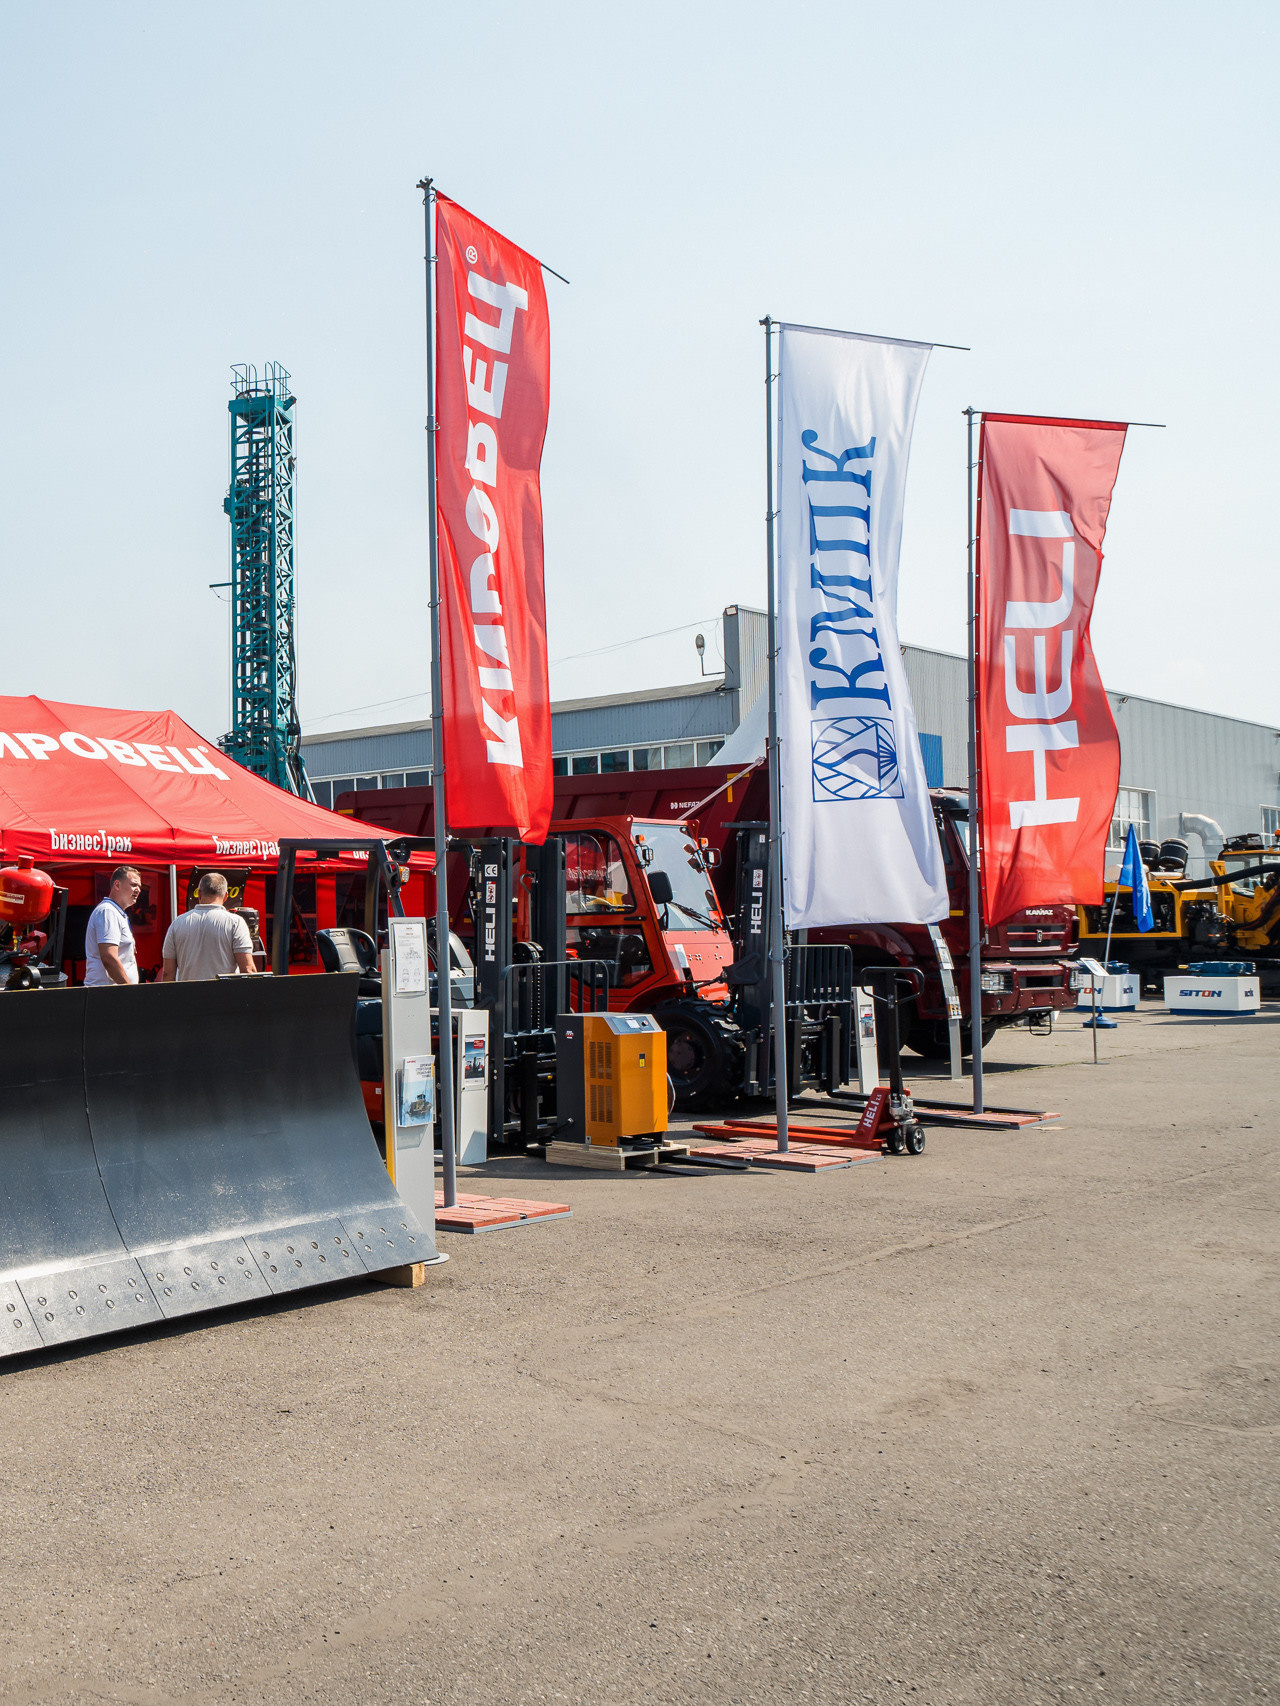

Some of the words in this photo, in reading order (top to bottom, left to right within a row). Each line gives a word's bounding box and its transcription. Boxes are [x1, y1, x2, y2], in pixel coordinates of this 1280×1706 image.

[801, 429, 891, 711] КМПК
[1004, 508, 1080, 829] HELI
[485, 907, 496, 961] HELI
[750, 891, 763, 934] HELI
[1179, 989, 1222, 998] SITON
[862, 1100, 880, 1128] HELI
